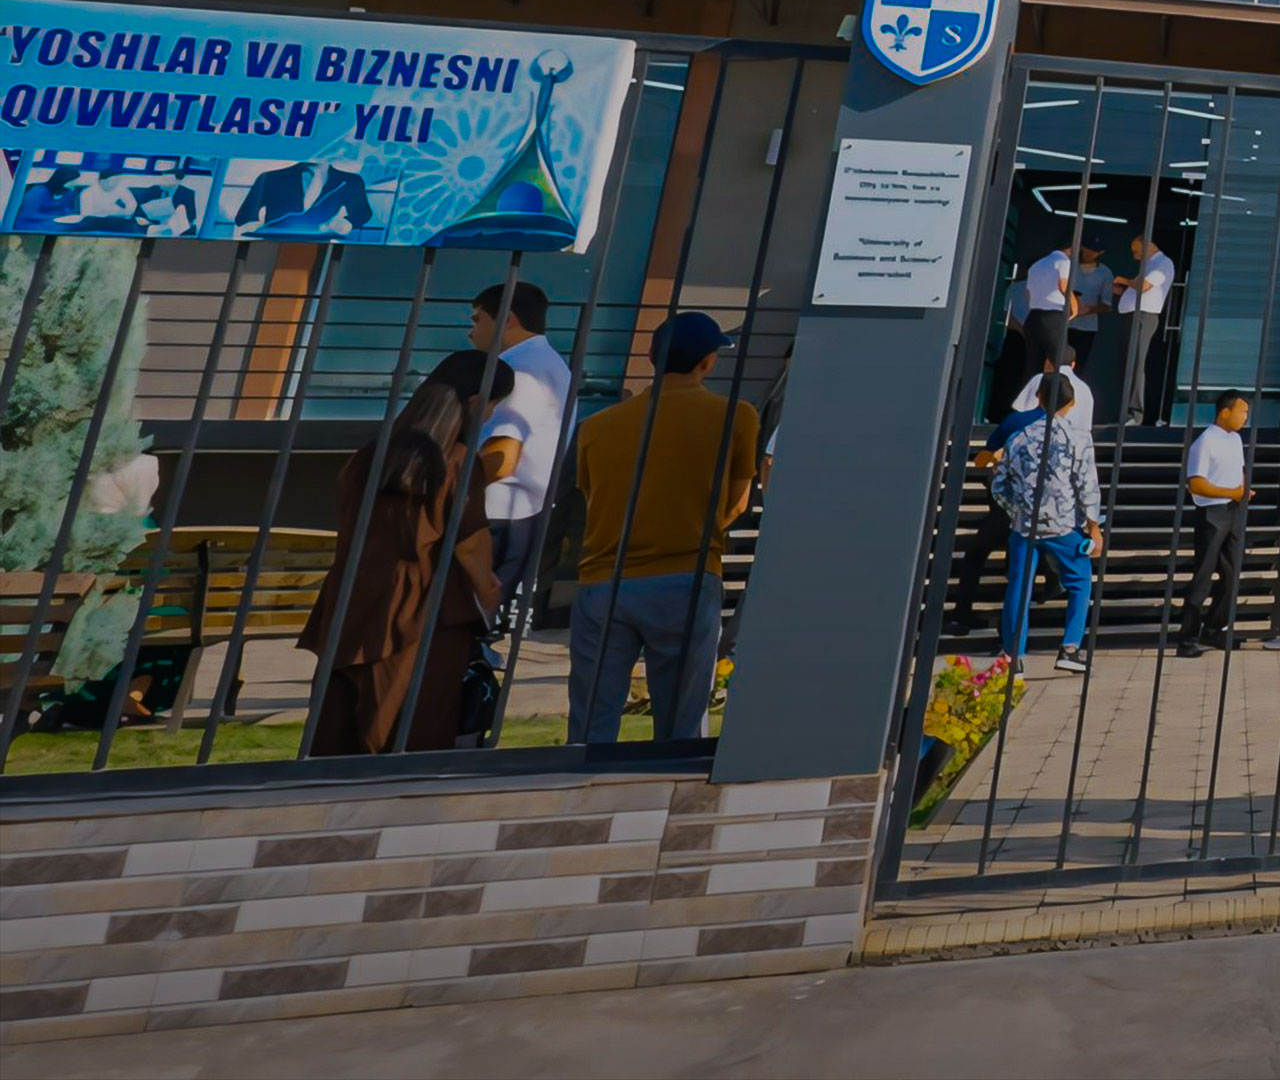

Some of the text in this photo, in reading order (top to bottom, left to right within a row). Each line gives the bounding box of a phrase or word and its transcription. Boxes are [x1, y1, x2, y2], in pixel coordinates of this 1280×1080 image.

[245, 41, 302, 81] VA
[314, 46, 520, 94] BIZNESNI
[353, 103, 435, 144] YILI
